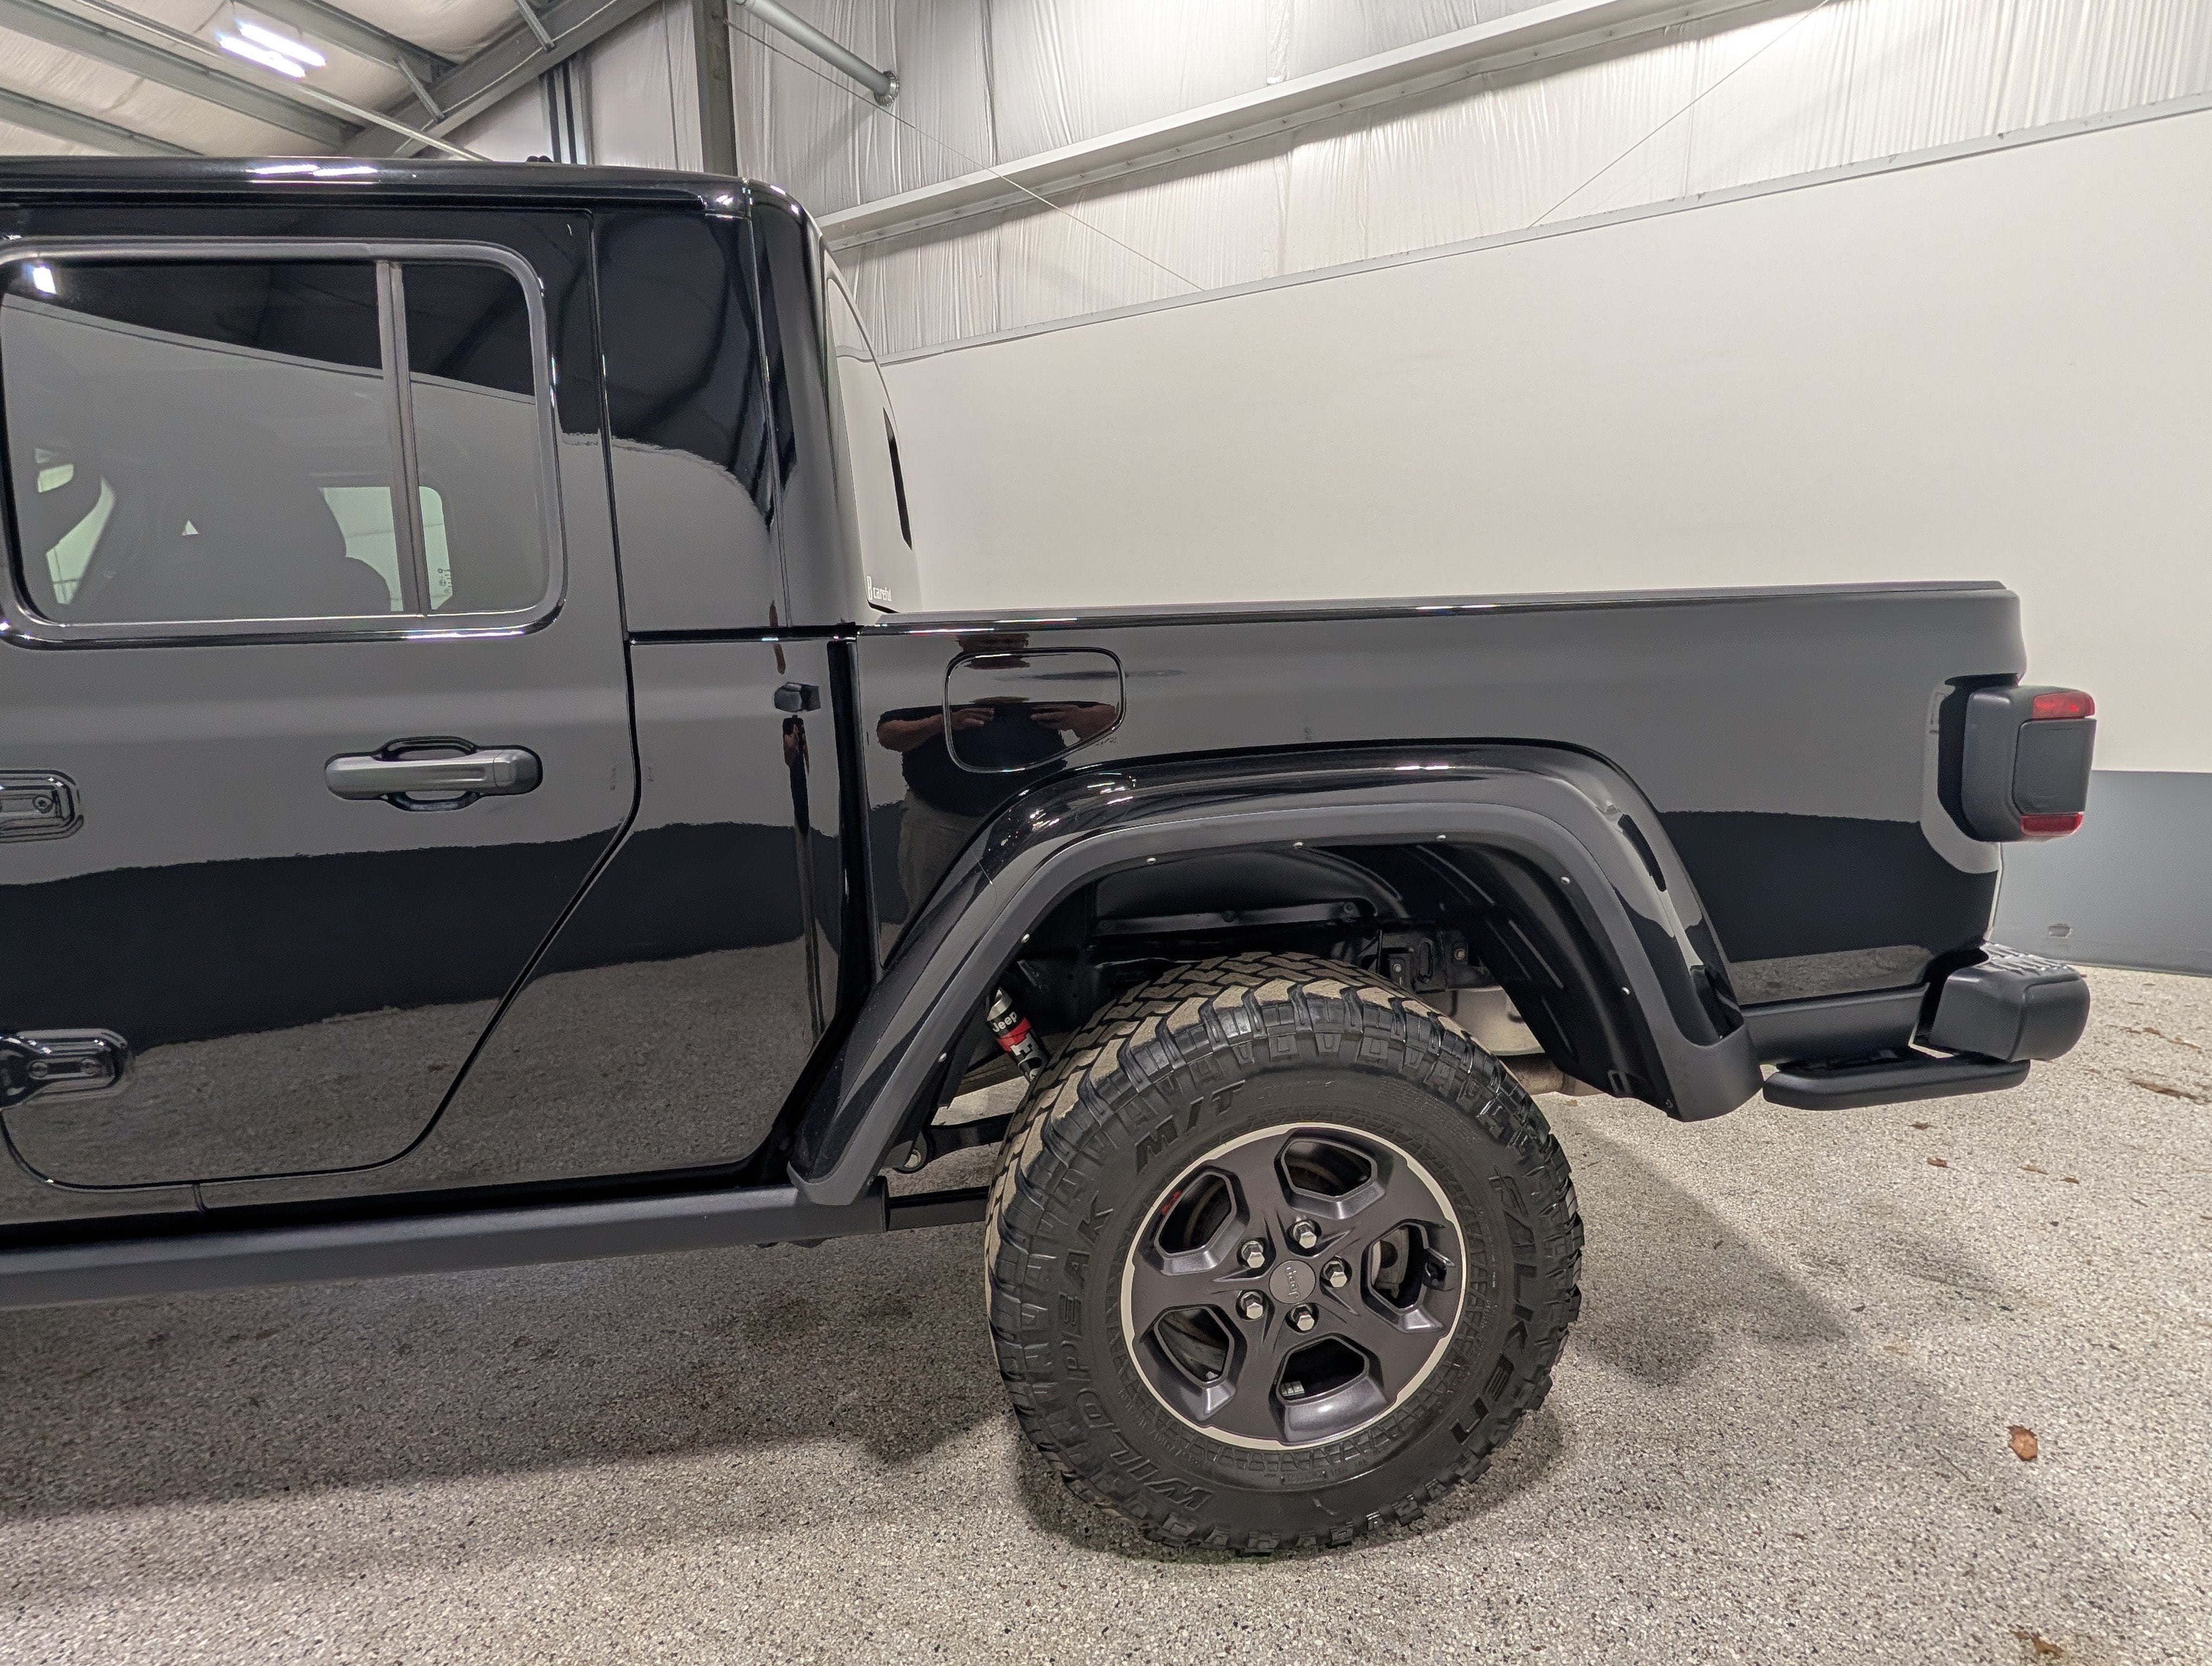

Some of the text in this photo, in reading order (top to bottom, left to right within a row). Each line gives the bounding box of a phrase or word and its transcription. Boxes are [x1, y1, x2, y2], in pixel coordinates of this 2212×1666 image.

[992, 1011, 1018, 1033] Jeep
[1009, 1033, 1049, 1082] FO
[1284, 1266, 1300, 1299] Jeep
[1058, 1190, 1213, 1511] WILDPEAK
